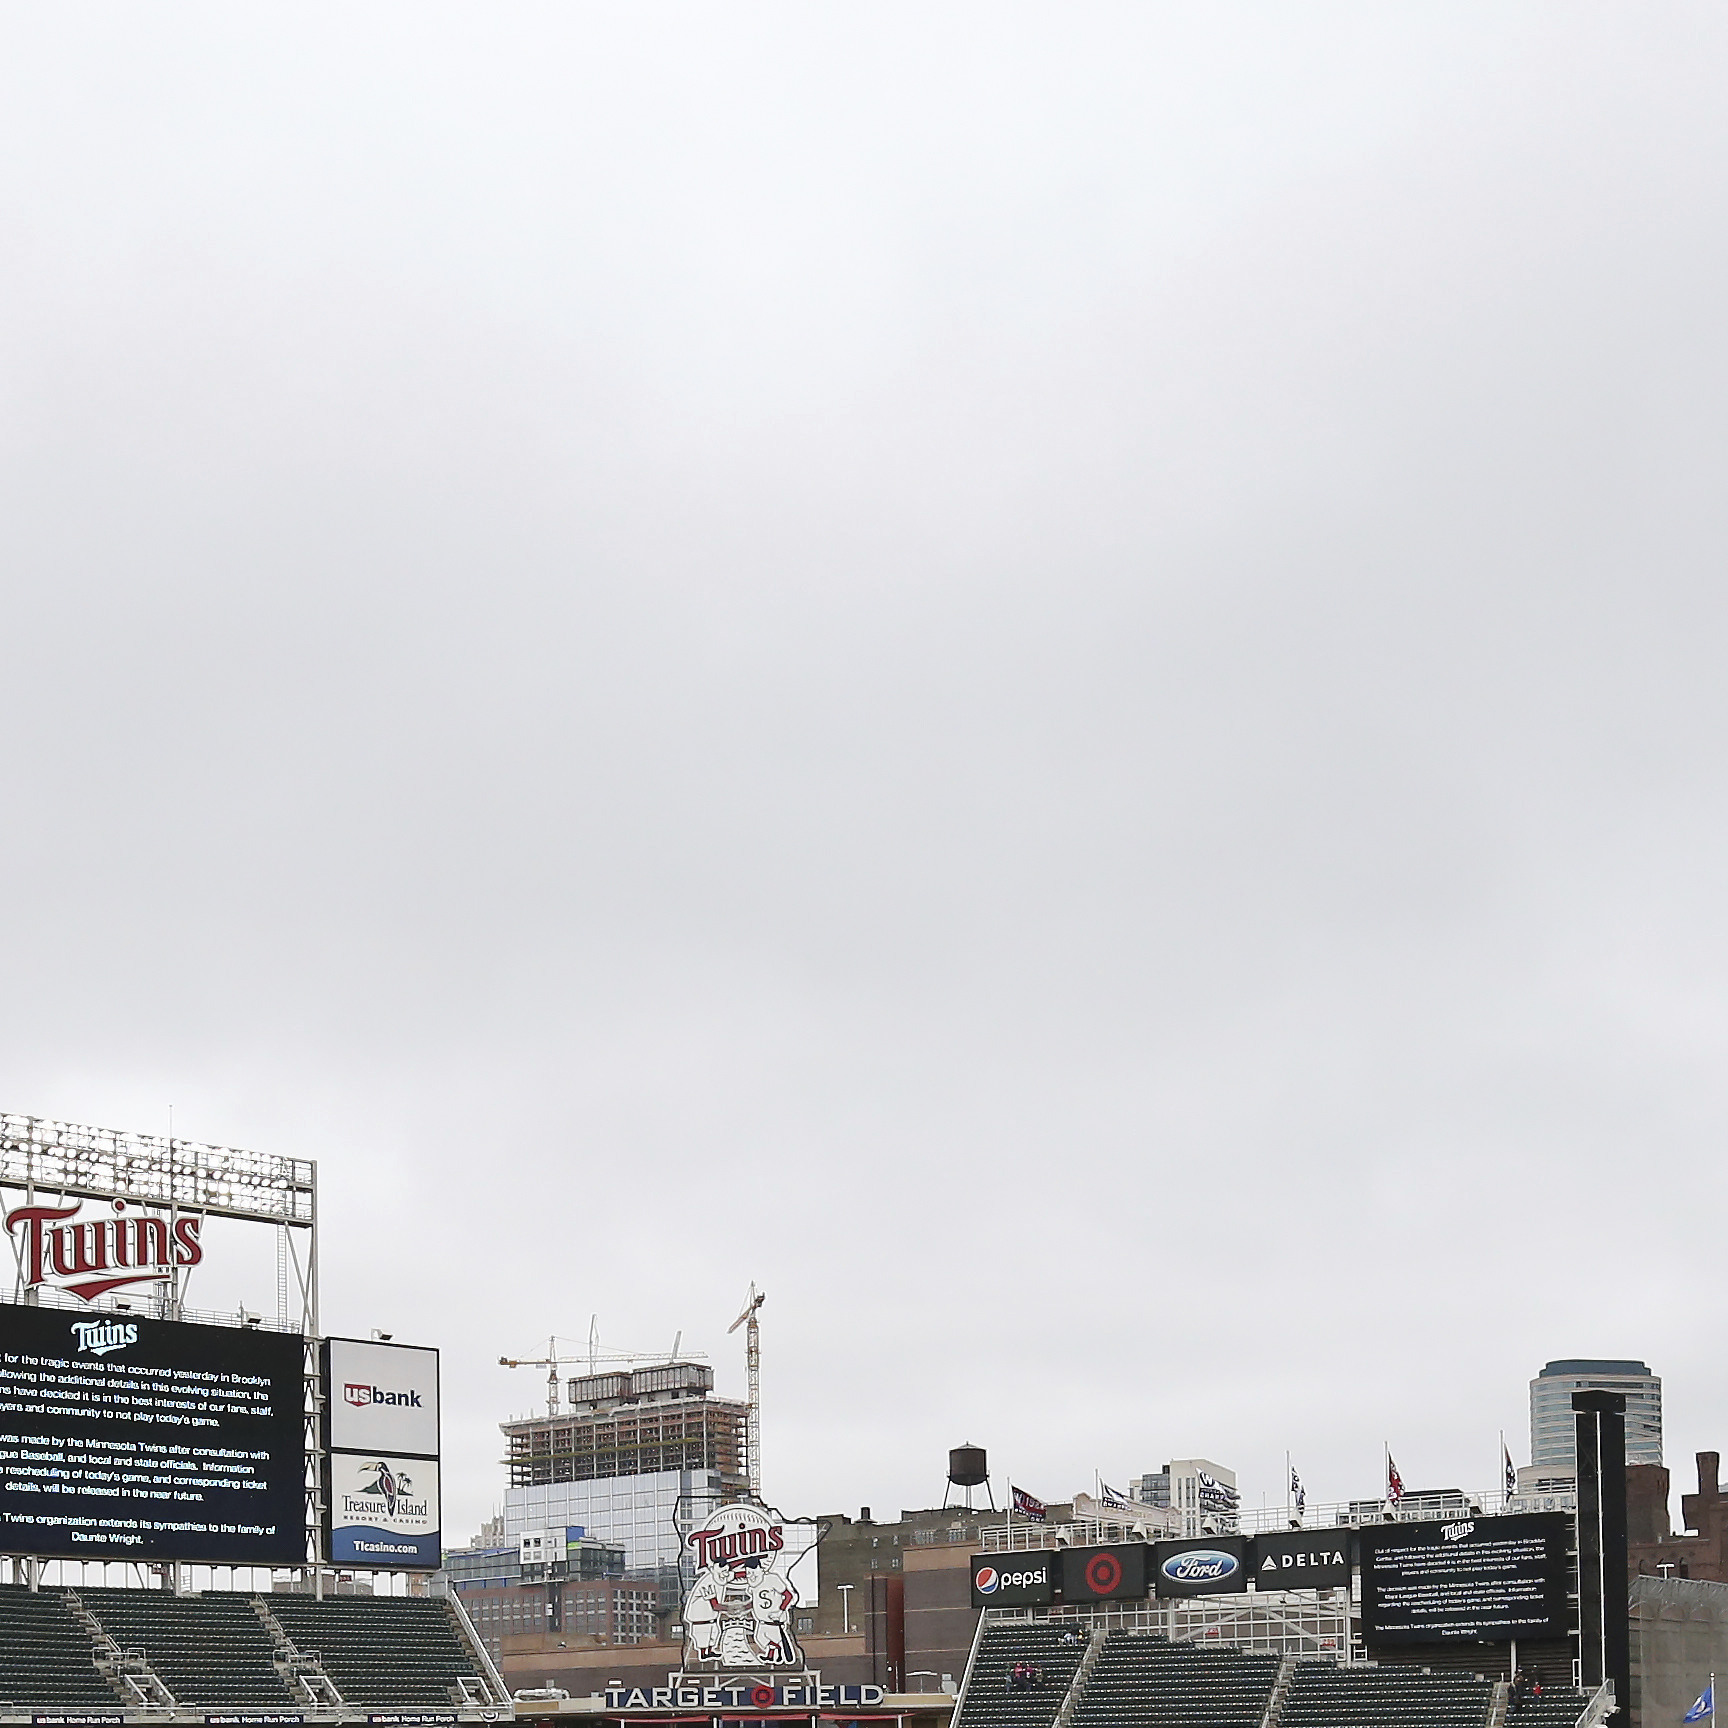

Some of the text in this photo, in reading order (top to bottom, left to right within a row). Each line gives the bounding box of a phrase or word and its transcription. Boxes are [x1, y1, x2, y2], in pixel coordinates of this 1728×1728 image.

[4, 1197, 205, 1302] Twins
[70, 1319, 140, 1357] Twins
[4, 1352, 19, 1363] for
[21, 1354, 38, 1365] the
[40, 1356, 69, 1368] tragic
[71, 1360, 105, 1371] events
[106, 1362, 126, 1373] that
[127, 1366, 171, 1377] occurred
[172, 1370, 219, 1382] yesterday
[220, 1372, 229, 1382] in
[231, 1373, 271, 1387] Brooklyn
[13, 1385, 38, 1397] have
[39, 1388, 80, 1400] decided
[82, 1391, 89, 1401] it
[91, 1392, 100, 1402] is
[102, 1392, 111, 1402] in
[113, 1394, 129, 1404] the
[131, 1395, 153, 1406] best
[154, 1397, 196, 1409] interests
[197, 1401, 207, 1410] of
[208, 1403, 225, 1411] our
[39, 1372, 56, 1382] the
[57, 1374, 105, 1386] additional
[106, 1378, 139, 1389] details
[140, 1380, 150, 1390] in
[151, 1382, 169, 1392] this
[170, 1384, 209, 1397] evolving
[253, 1391, 268, 1400] the
[342, 1495, 427, 1516] Treasure Island
[1441, 1521, 1475, 1541] Twins
[688, 1522, 784, 1570] Twins
[1176, 1555, 1223, 1579] Ford
[1281, 1551, 1345, 1568] DELTA
[1001, 1567, 1047, 1590] pepsi
[605, 1684, 885, 1709] TARGET FIELD
